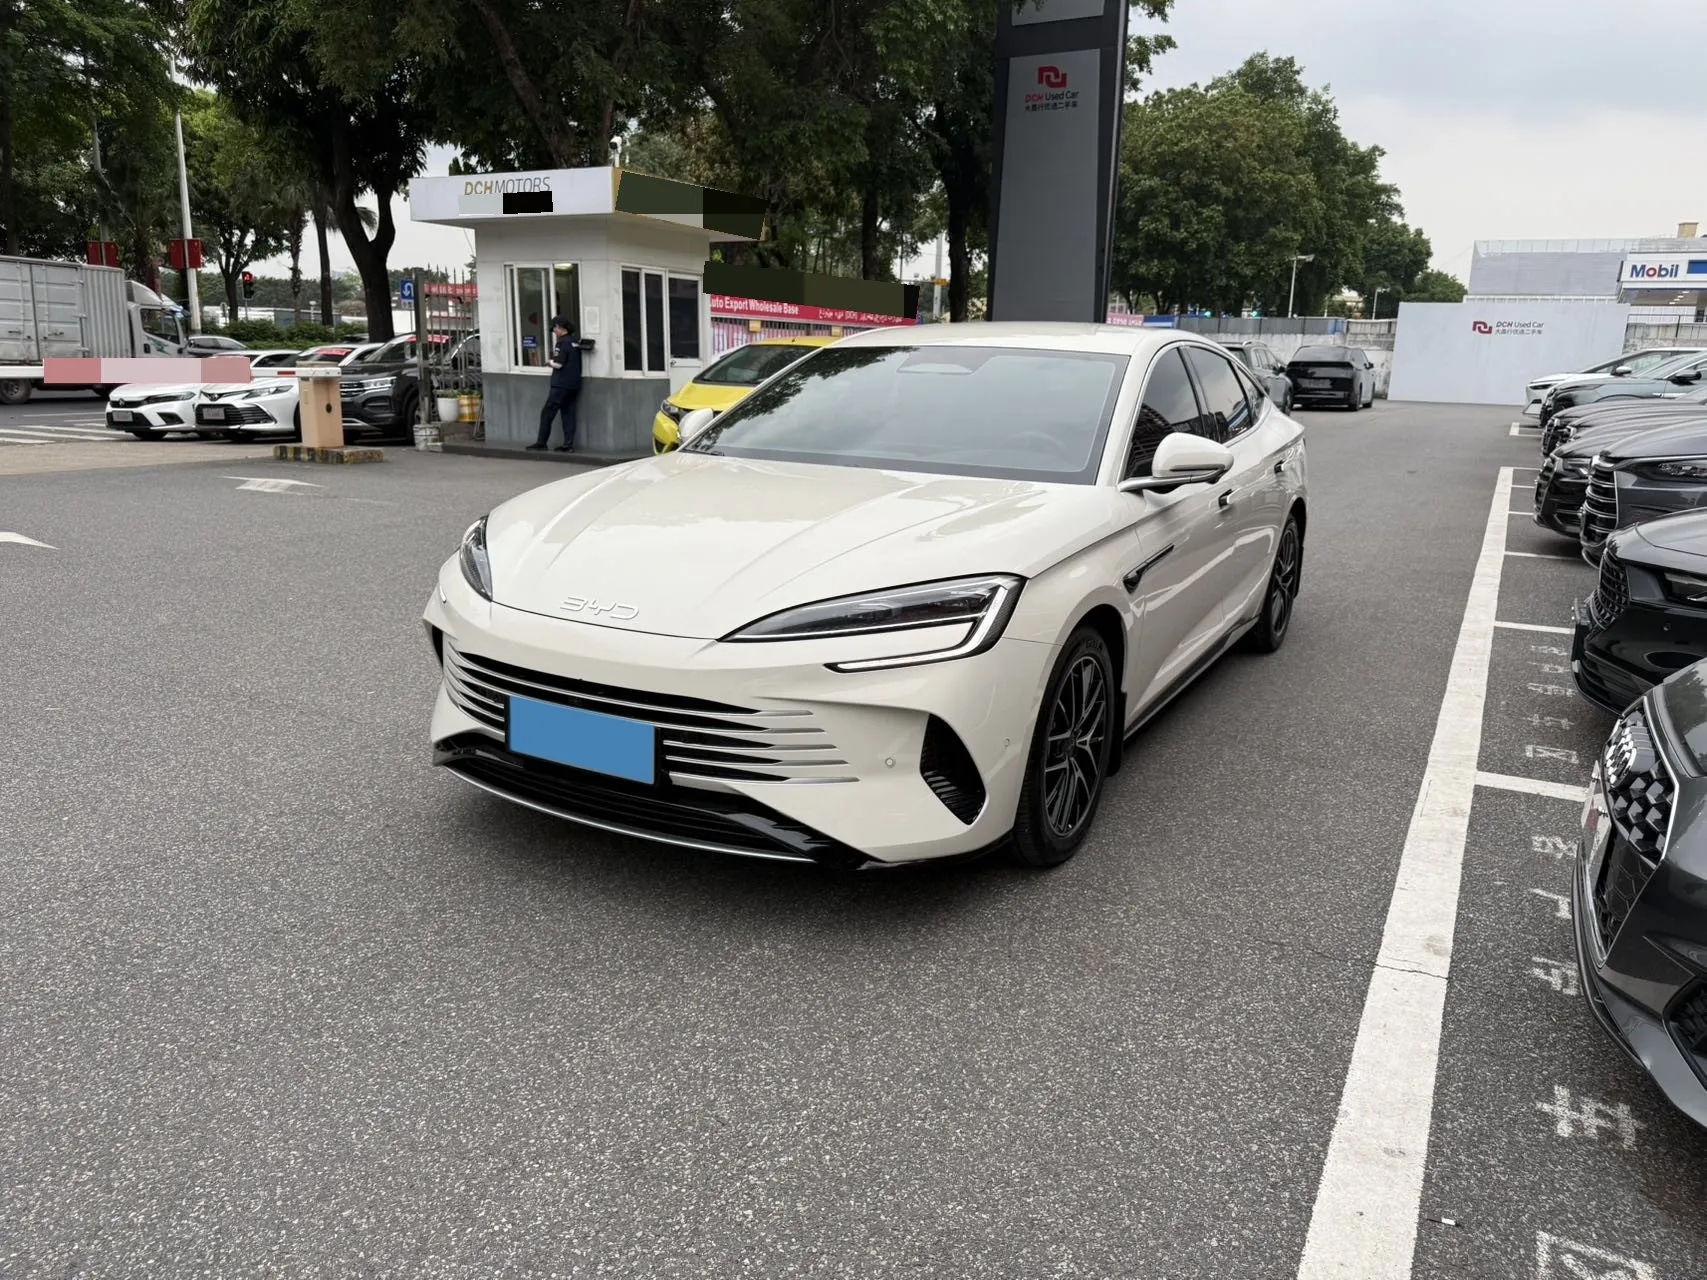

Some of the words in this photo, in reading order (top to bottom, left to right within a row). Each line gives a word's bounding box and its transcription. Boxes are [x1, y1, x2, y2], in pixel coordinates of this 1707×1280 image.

[1045, 92, 1064, 100] Used
[1065, 91, 1079, 99] Car
[1630, 264, 1679, 278] Mobil
[711, 296, 724, 308] uto
[724, 297, 748, 311] Export
[748, 299, 783, 312] Wholesale
[783, 303, 799, 314] Base
[559, 597, 639, 620] BYD
